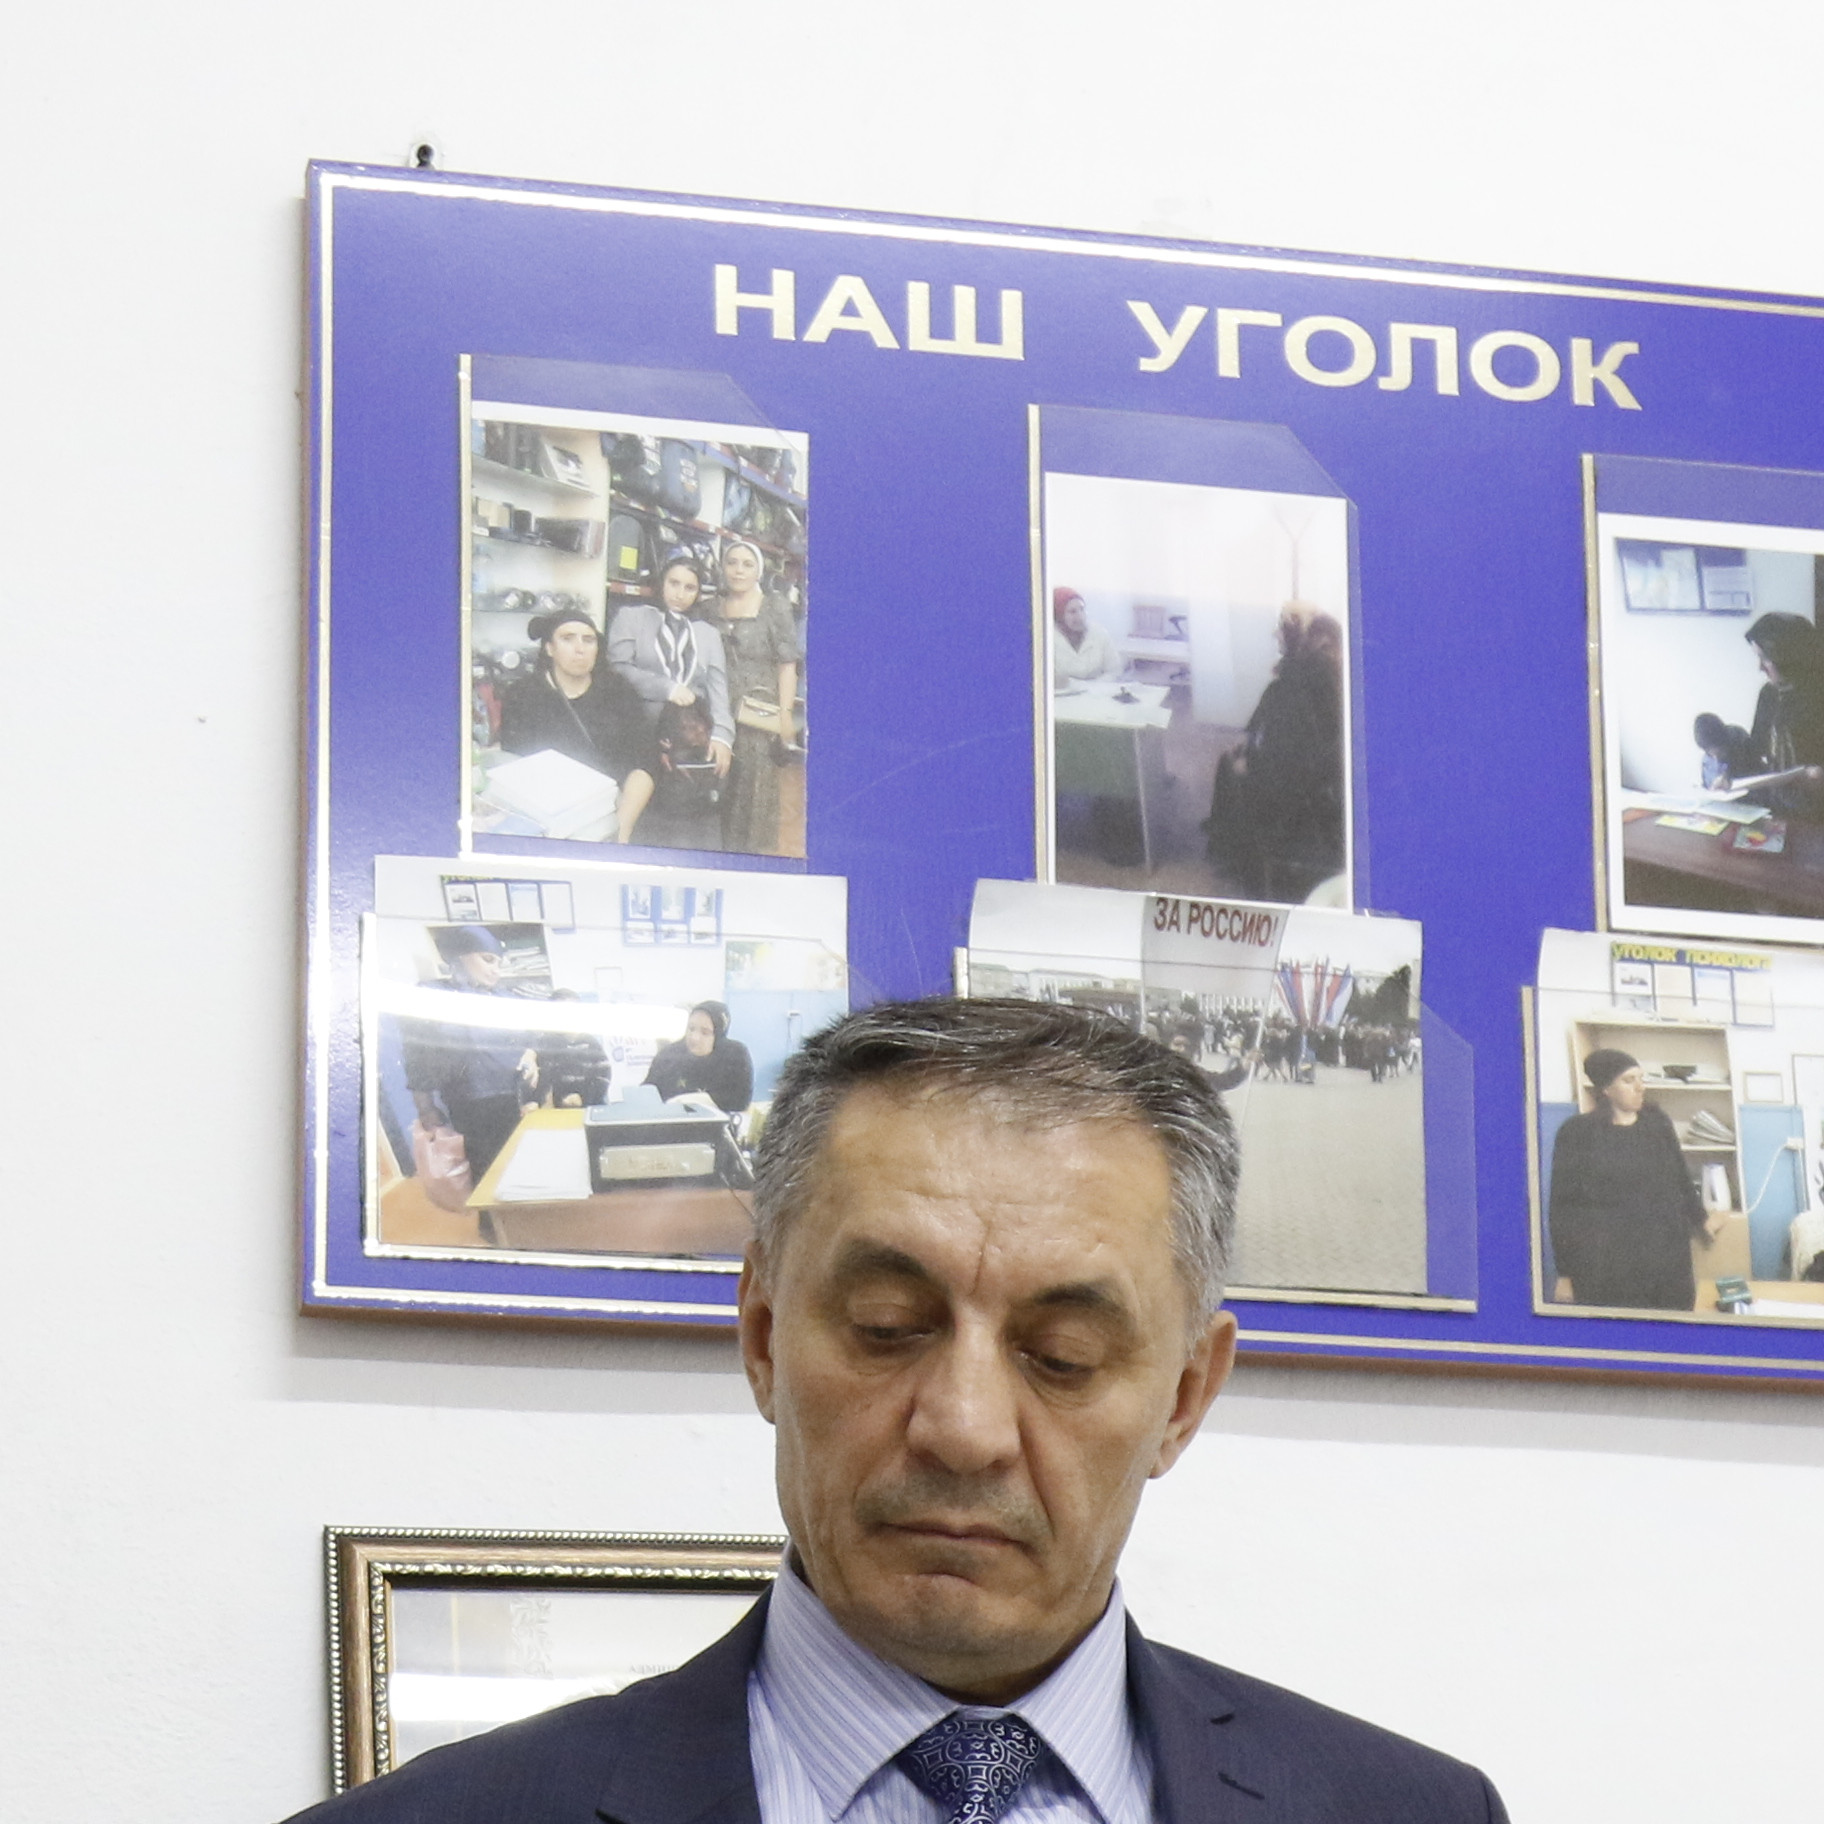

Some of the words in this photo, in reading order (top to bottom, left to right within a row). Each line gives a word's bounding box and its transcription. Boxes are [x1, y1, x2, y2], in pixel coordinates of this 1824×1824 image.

[714, 263, 1025, 361] НАШ
[1127, 299, 1644, 411] УГОЛОК
[1153, 897, 1181, 934] ЗА
[1187, 901, 1279, 948] РОССИЮ!
